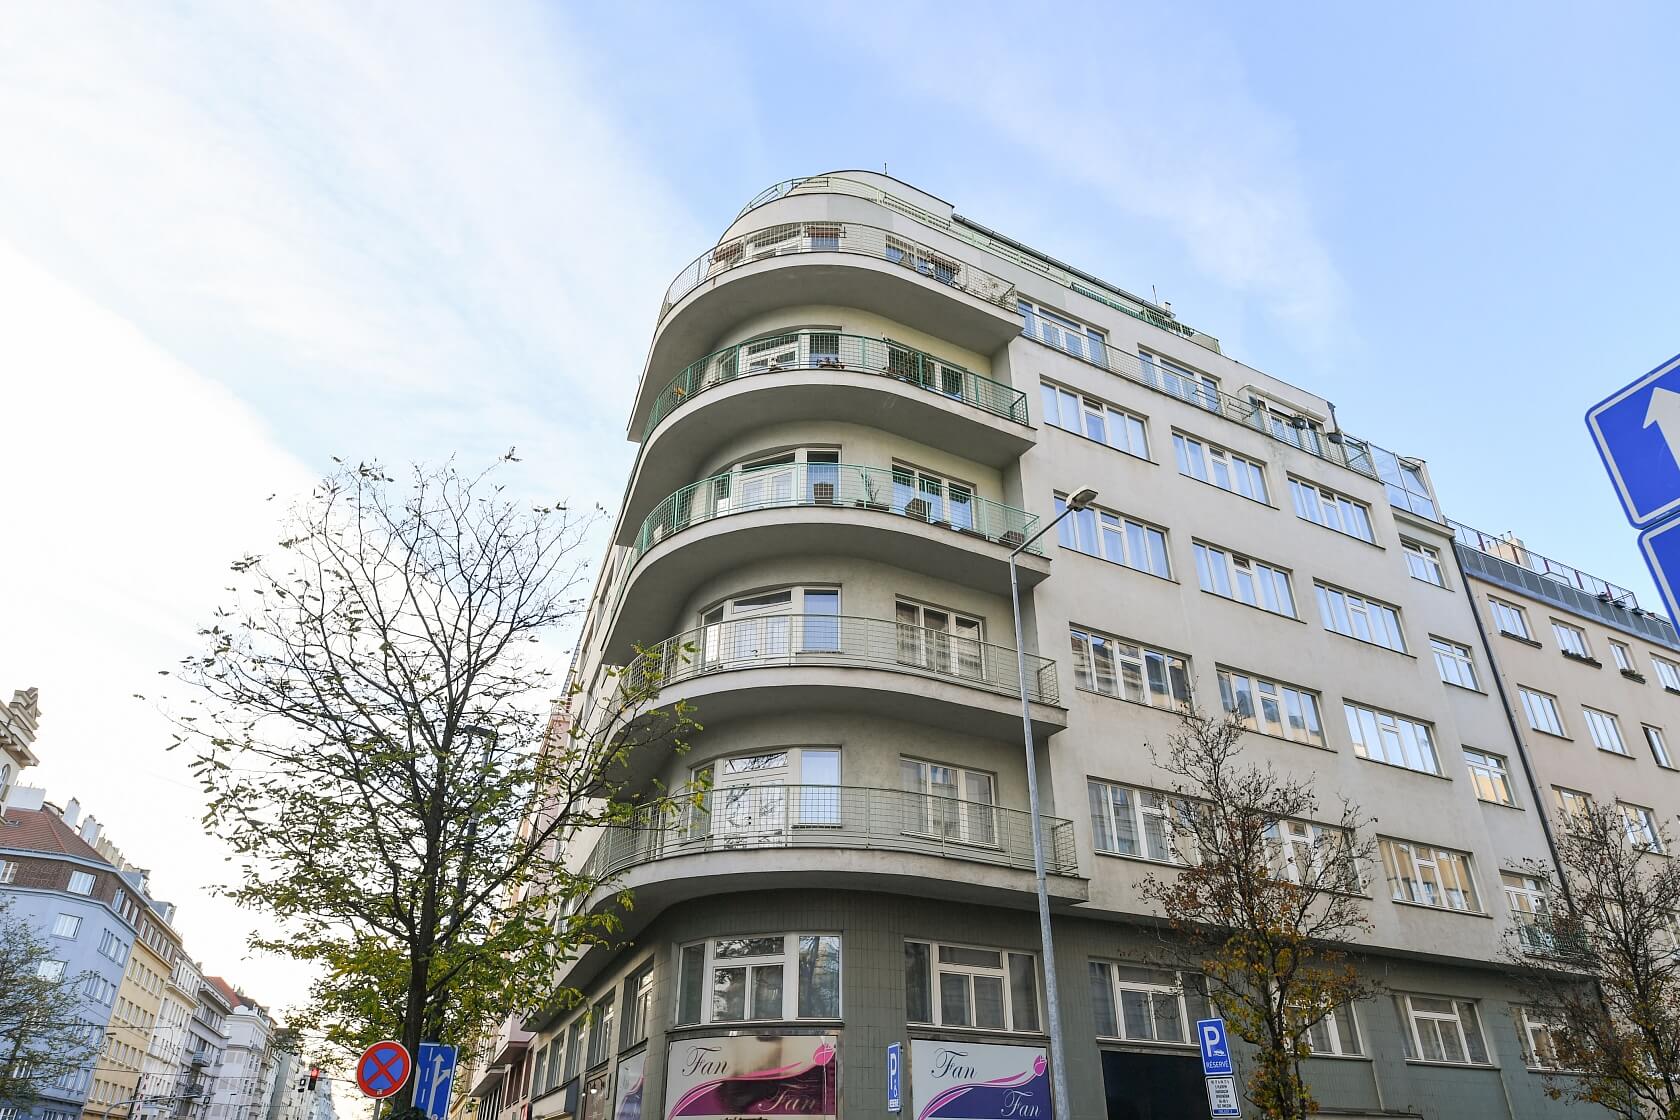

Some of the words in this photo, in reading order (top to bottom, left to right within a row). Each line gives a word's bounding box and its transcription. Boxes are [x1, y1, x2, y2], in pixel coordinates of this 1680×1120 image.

[1203, 1026, 1220, 1057] P
[682, 1045, 729, 1077] Fan
[890, 1053, 897, 1090] P
[930, 1047, 978, 1079] Fan
[758, 1081, 817, 1112] Fan
[1001, 1088, 1042, 1117] Fan
